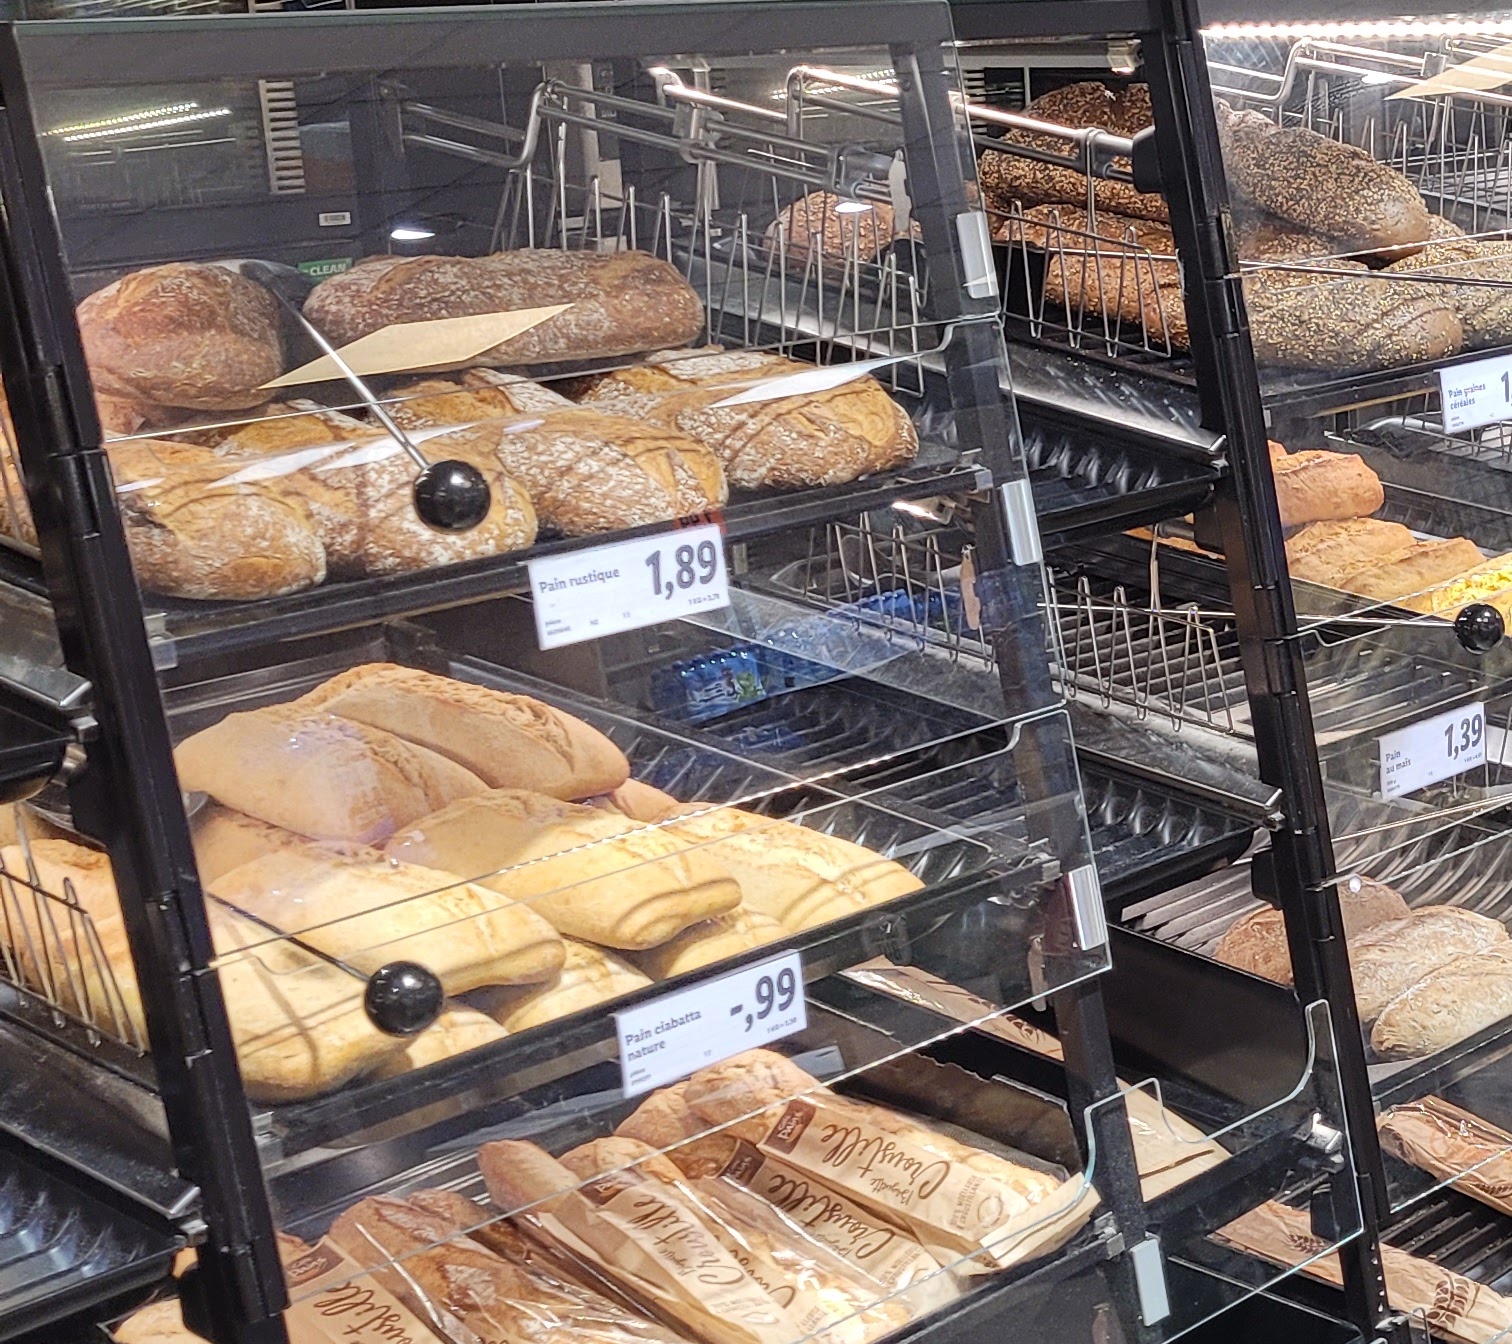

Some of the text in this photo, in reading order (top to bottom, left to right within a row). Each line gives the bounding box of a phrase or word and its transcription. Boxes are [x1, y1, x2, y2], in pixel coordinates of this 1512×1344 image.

[310, 263, 347, 276] CLEAN
[538, 568, 621, 593] Pain rustique
[645, 540, 717, 600] 1,89
[1444, 714, 1483, 760] 1,39
[1385, 749, 1401, 762] Pain
[730, 967, 796, 1033] -,99
[625, 1009, 702, 1046] Pain ciabatta
[627, 1040, 666, 1061] nature
